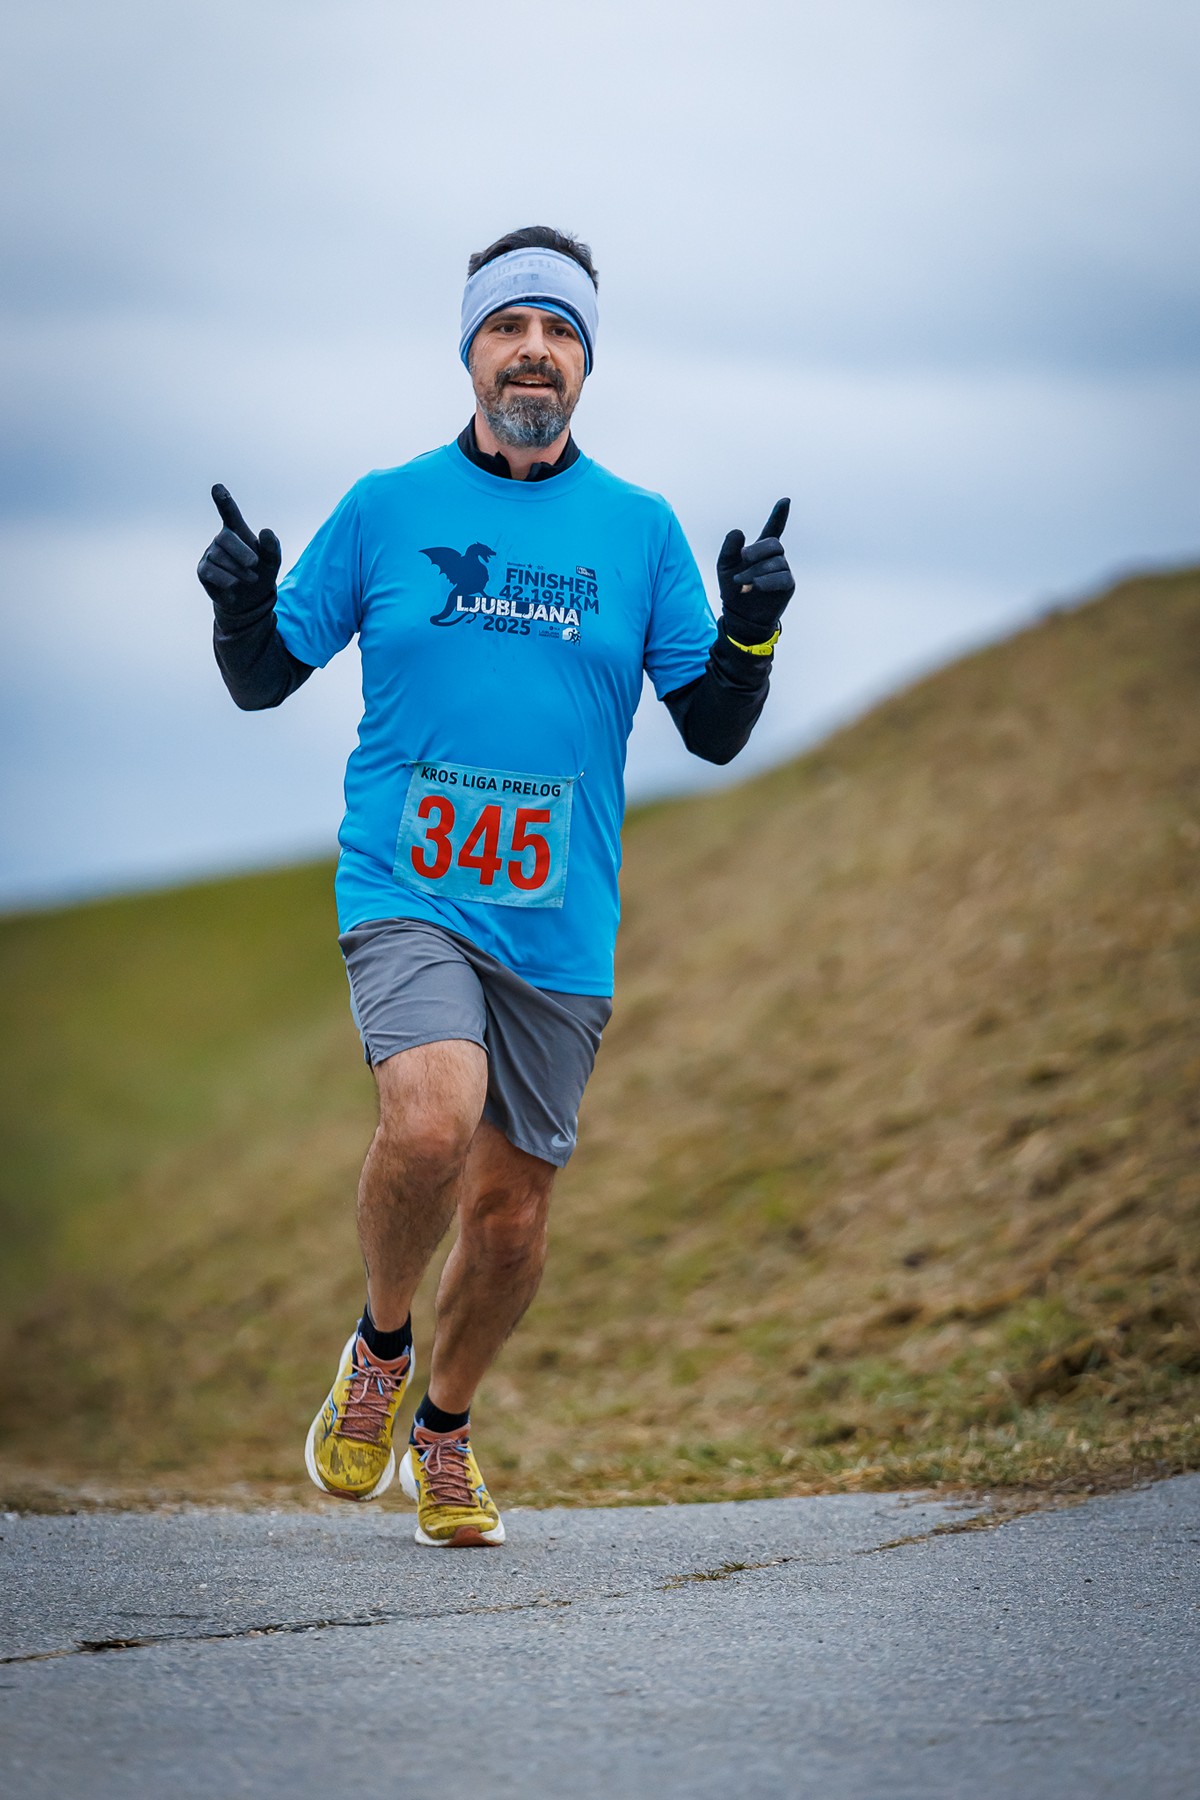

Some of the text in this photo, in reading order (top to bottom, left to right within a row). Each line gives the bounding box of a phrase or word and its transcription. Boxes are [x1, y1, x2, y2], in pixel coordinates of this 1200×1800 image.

[505, 568, 599, 598] FINISHER
[456, 595, 580, 626] LJUBLJANA
[499, 585, 599, 615] 42.195 KM
[483, 616, 531, 636] 2025
[421, 766, 561, 797] KROS LIGA PRELOG
[411, 795, 551, 890] 345
